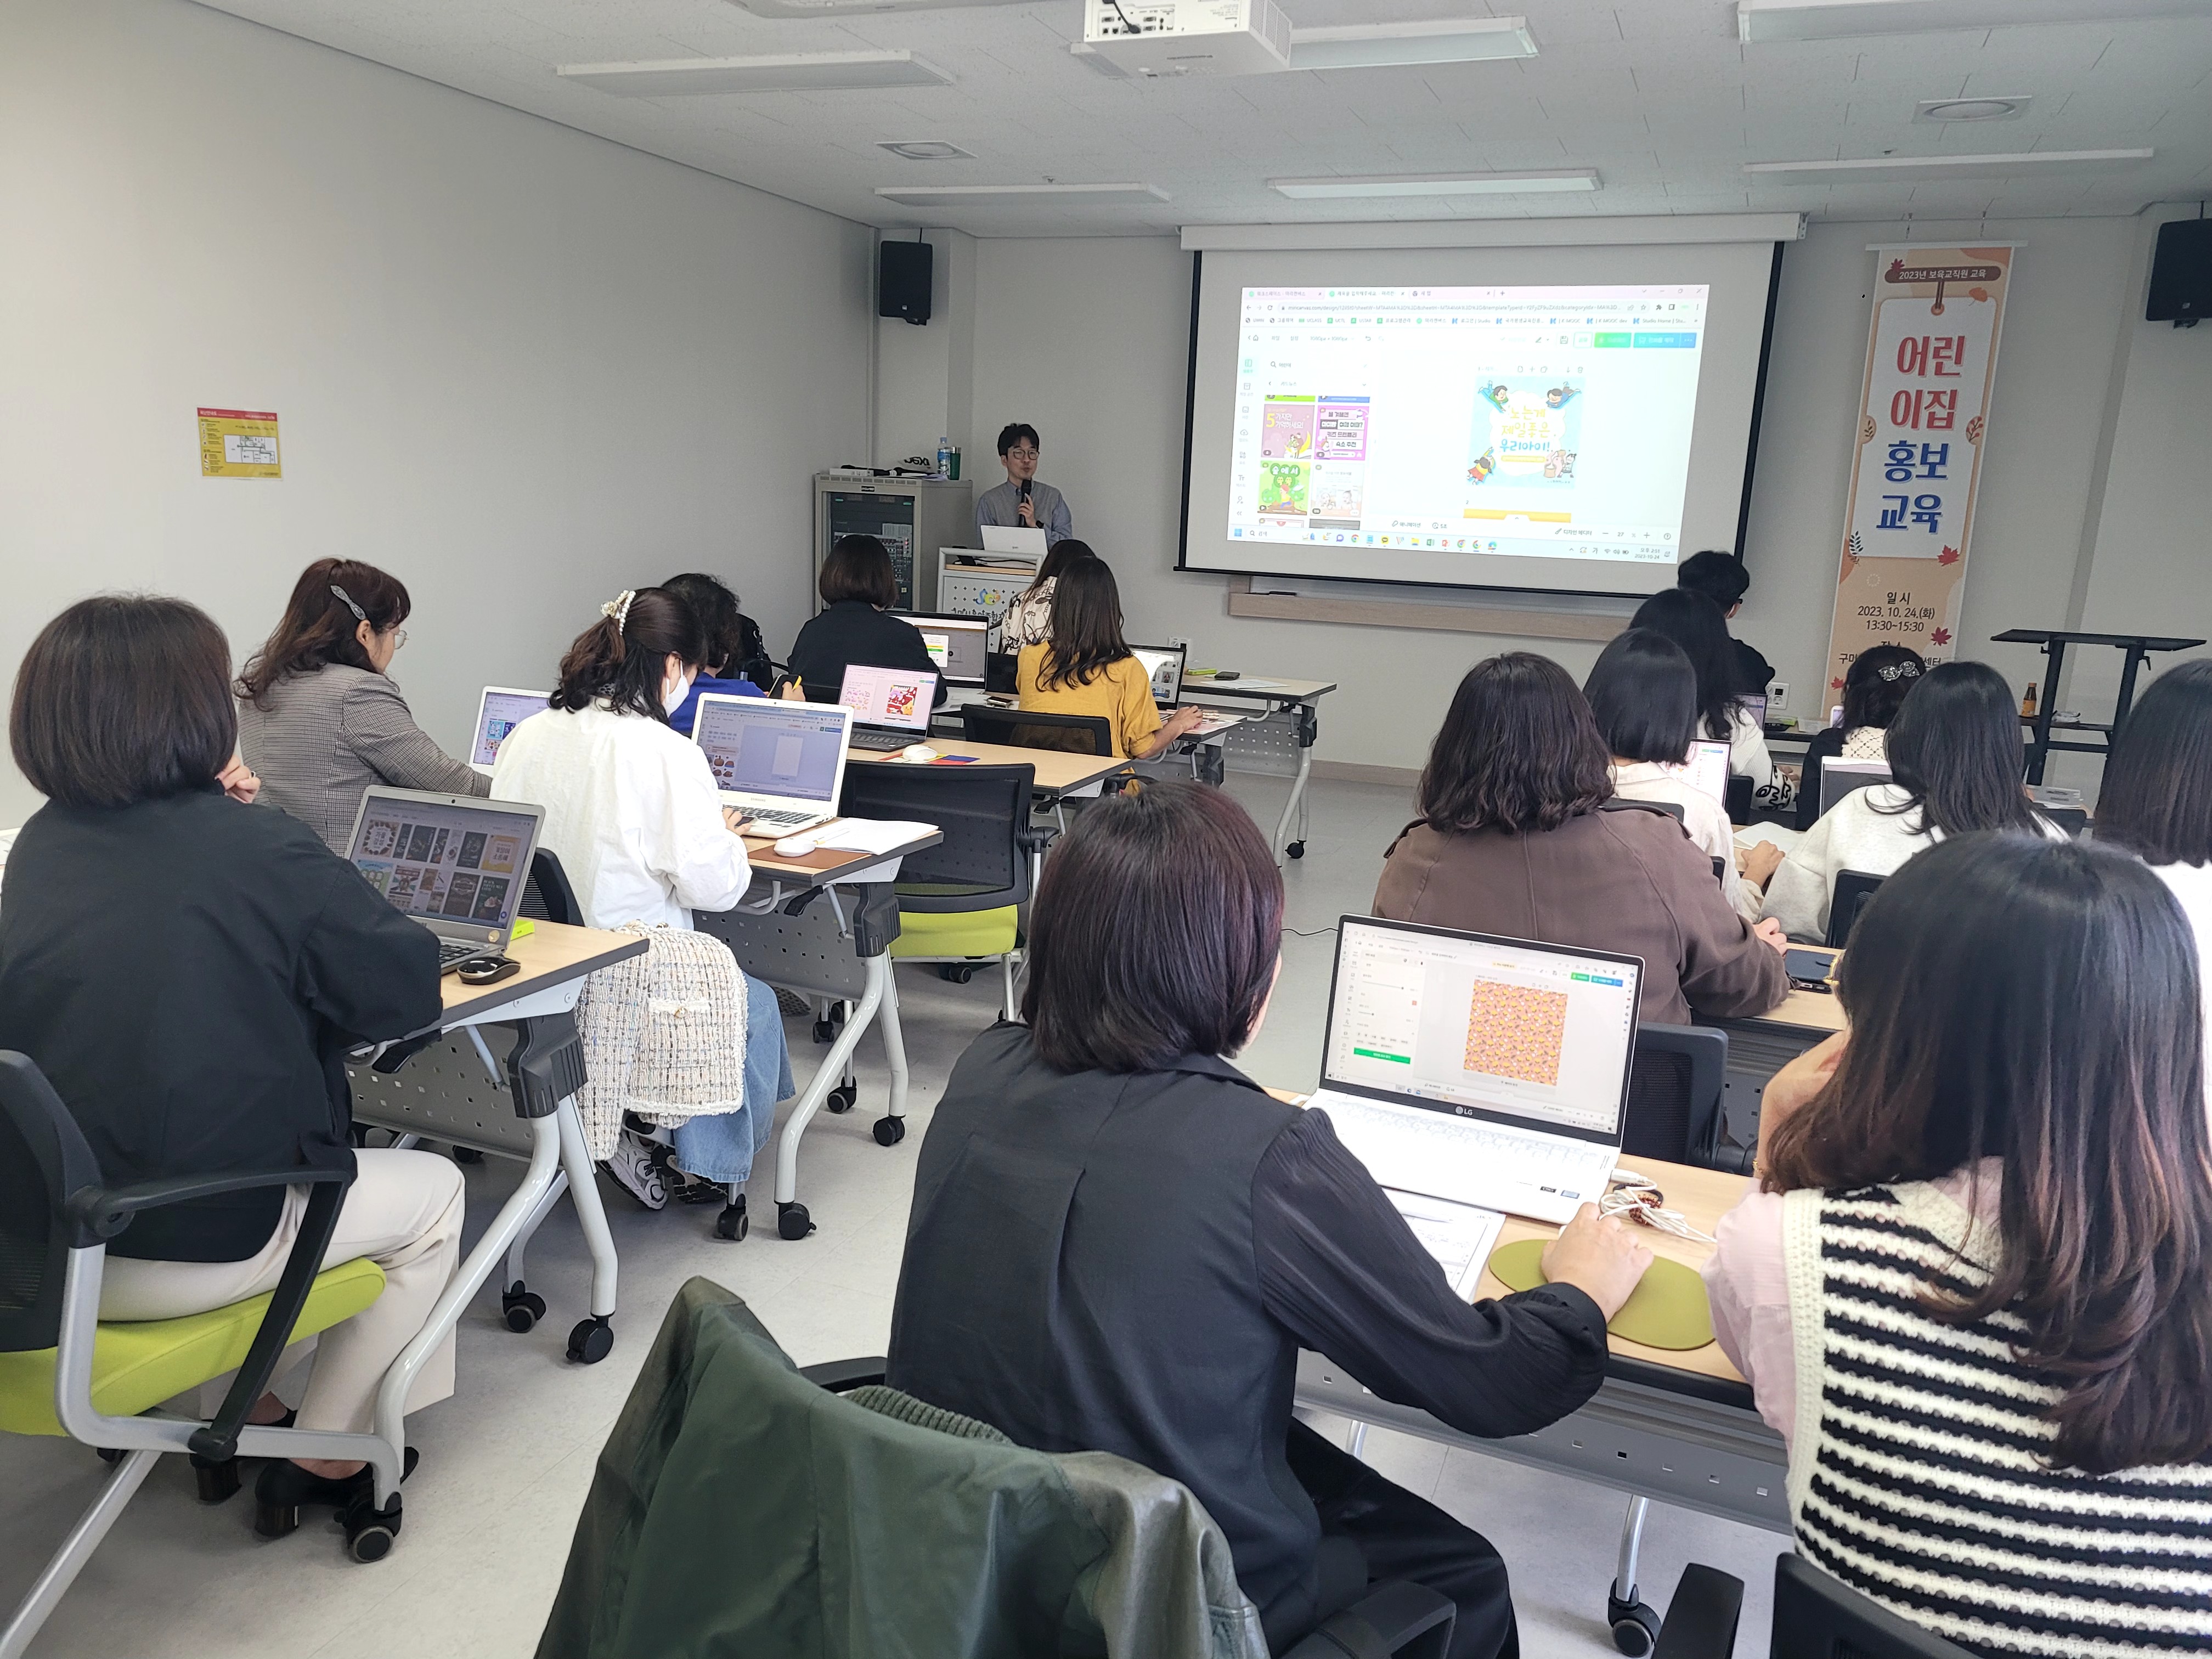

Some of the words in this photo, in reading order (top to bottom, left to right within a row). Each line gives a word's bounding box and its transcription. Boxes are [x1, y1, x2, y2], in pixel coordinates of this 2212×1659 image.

[1899, 270, 1927, 280] 2023년
[1928, 269, 1968, 279] 보육교직원
[1970, 269, 1987, 278] 교육
[1897, 335, 1966, 377] 어린
[1276, 413, 1293, 421] 가지만
[1510, 405, 1546, 420] 노는게
[1891, 389, 1958, 431] 이집
[1266, 413, 1275, 428] 5
[1501, 421, 1551, 438] 제일좋은
[1499, 439, 1550, 452] 우리아이!
[1884, 440, 1949, 482] 홍보
[1876, 494, 1942, 534] 교육
[1858, 606, 1884, 617] 2023.
[1887, 607, 1902, 618] 10.
[1904, 607, 1936, 620] 24.(화)
[1866, 620, 1925, 632] 13:30~15:30
